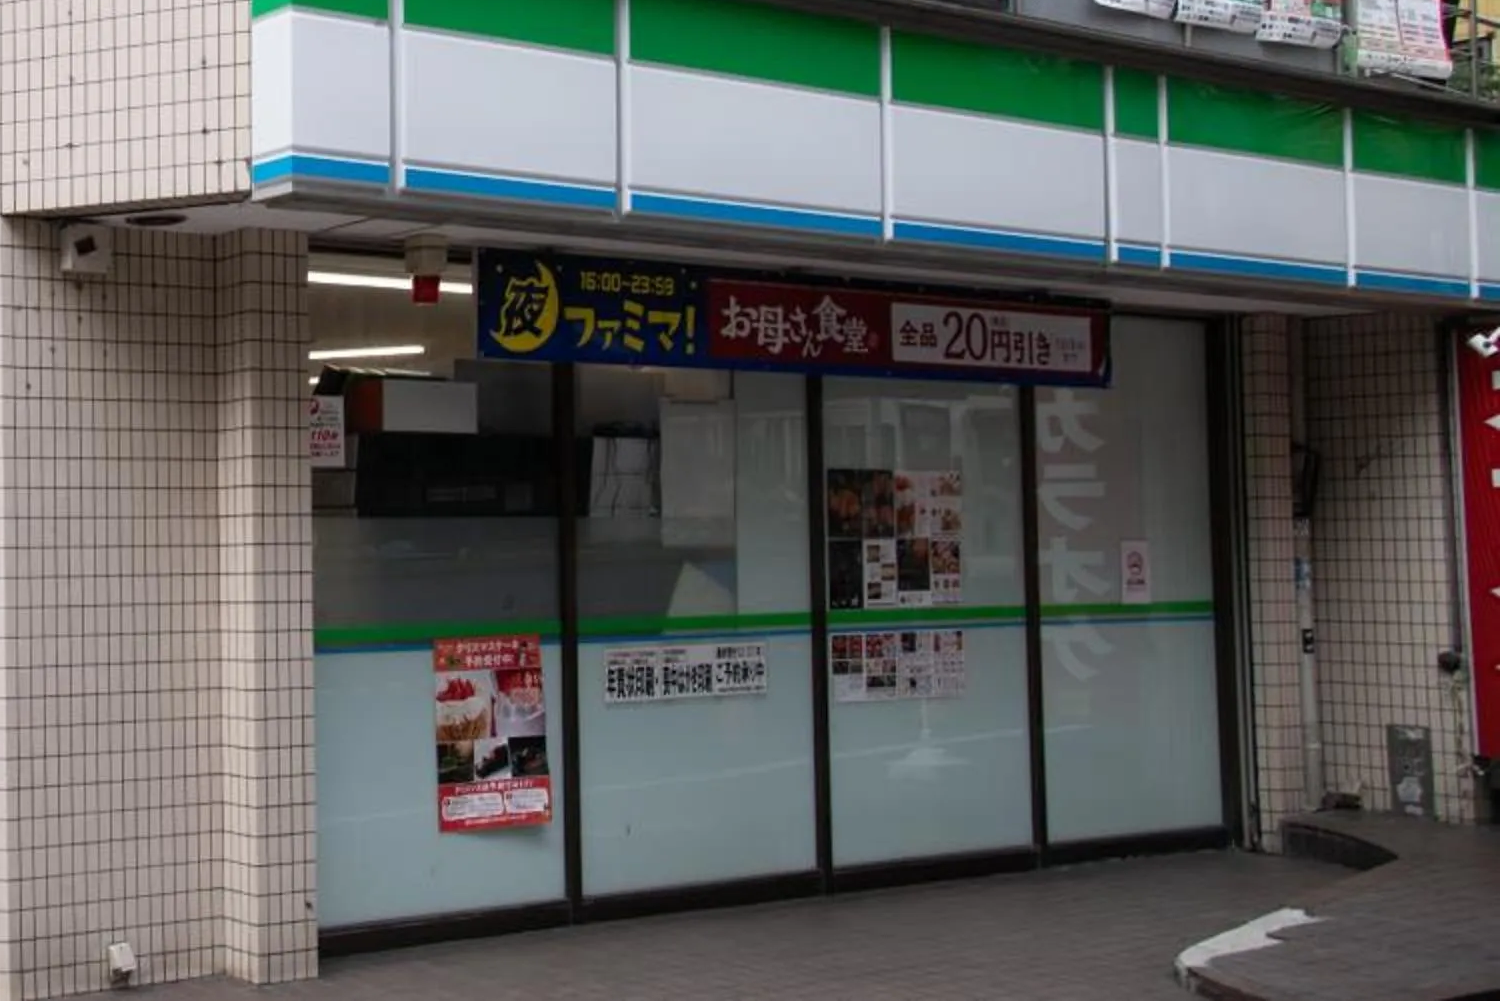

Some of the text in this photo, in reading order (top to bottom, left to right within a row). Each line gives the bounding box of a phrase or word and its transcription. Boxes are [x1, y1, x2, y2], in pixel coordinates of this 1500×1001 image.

[721, 295, 869, 359] お母さん食堂
